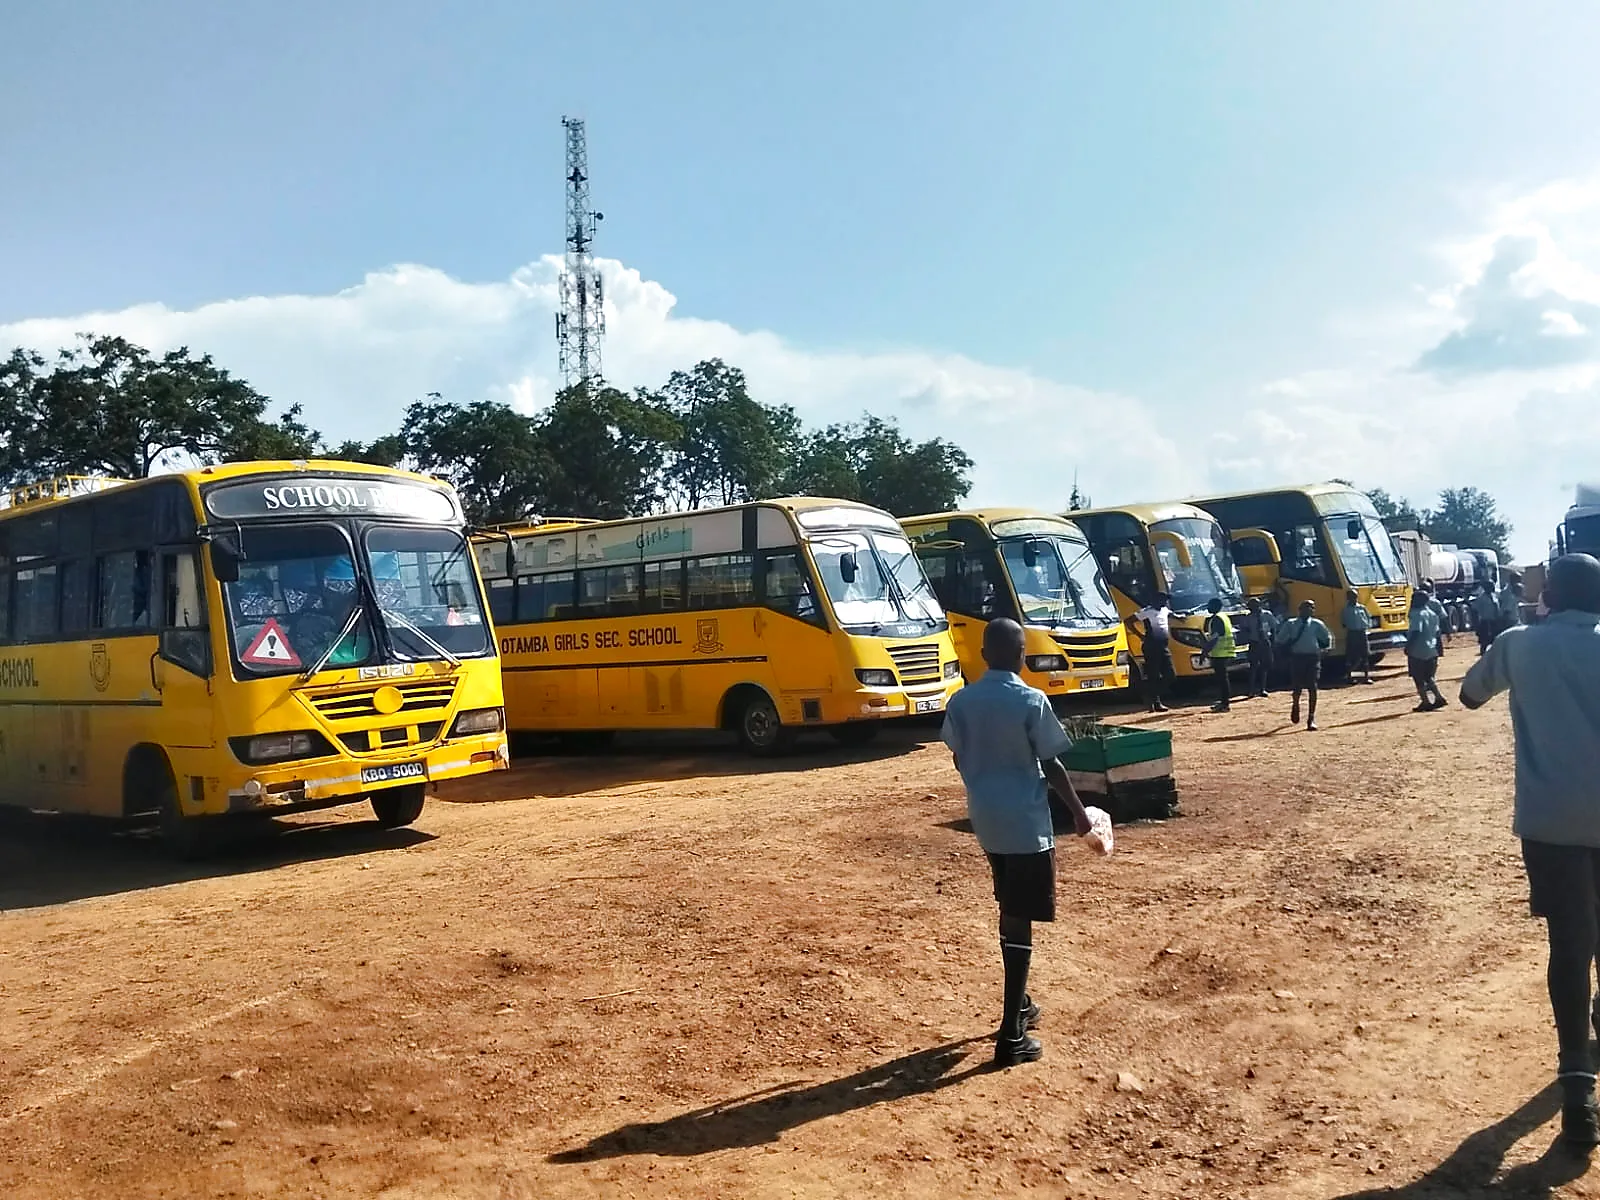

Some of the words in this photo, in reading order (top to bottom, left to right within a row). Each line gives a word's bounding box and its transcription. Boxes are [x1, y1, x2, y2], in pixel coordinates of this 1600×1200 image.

[263, 485, 366, 509] SCHOOL
[636, 526, 670, 550] Girls
[501, 635, 550, 654] OTAMBA
[554, 632, 589, 650] GIRLS
[595, 631, 623, 648] SEC.
[628, 627, 682, 645] SCHOOL
[0, 658, 39, 688] CHOOL
[360, 663, 415, 680] ISUZU
